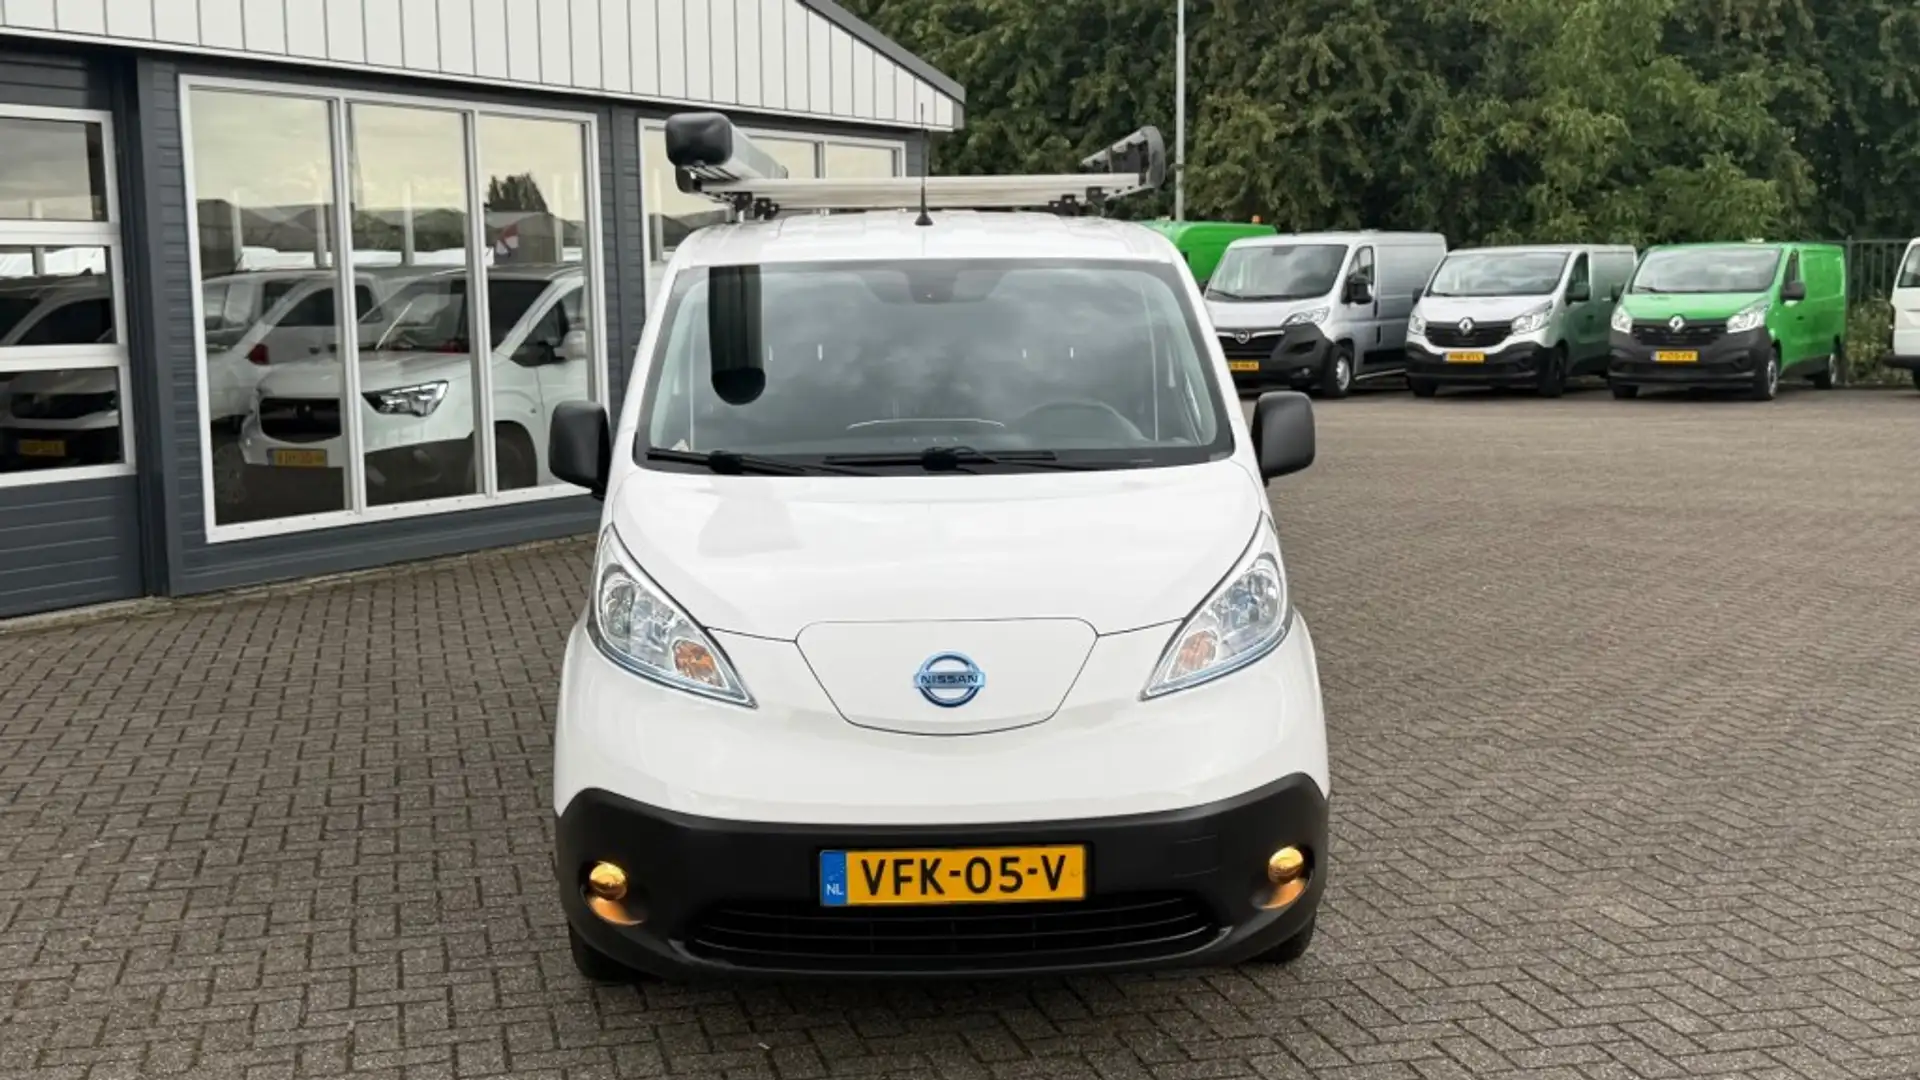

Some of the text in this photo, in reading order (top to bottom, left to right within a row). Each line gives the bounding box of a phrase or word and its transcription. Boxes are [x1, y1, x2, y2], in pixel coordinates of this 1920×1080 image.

[921, 675, 978, 684] NISSAN
[861, 854, 1067, 896] VFK-05-V
[826, 884, 845, 896] NL
